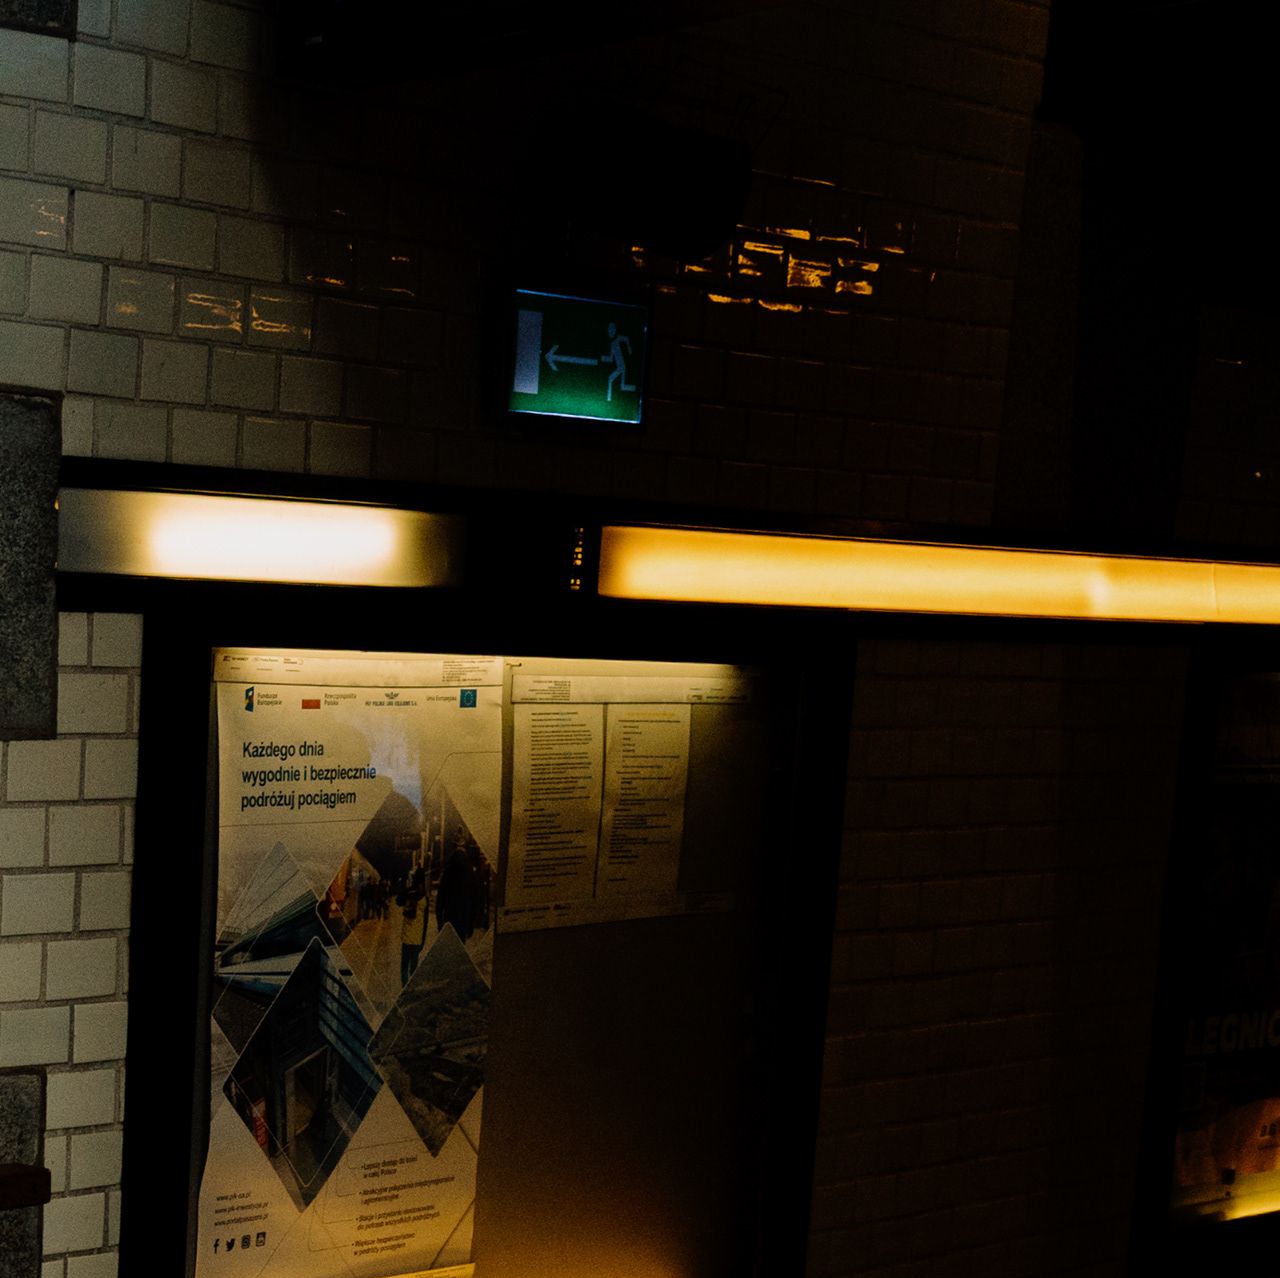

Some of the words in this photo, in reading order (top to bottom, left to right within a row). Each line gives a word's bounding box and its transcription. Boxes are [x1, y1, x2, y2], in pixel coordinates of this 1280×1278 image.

[243, 742, 296, 760] Każdego
[299, 741, 324, 756] dnia
[242, 766, 300, 786] wygodnie
[304, 766, 307, 780] i
[310, 764, 376, 784] bezpiecznie
[241, 790, 295, 812] podróżuj
[298, 788, 356, 810] pociągiem
